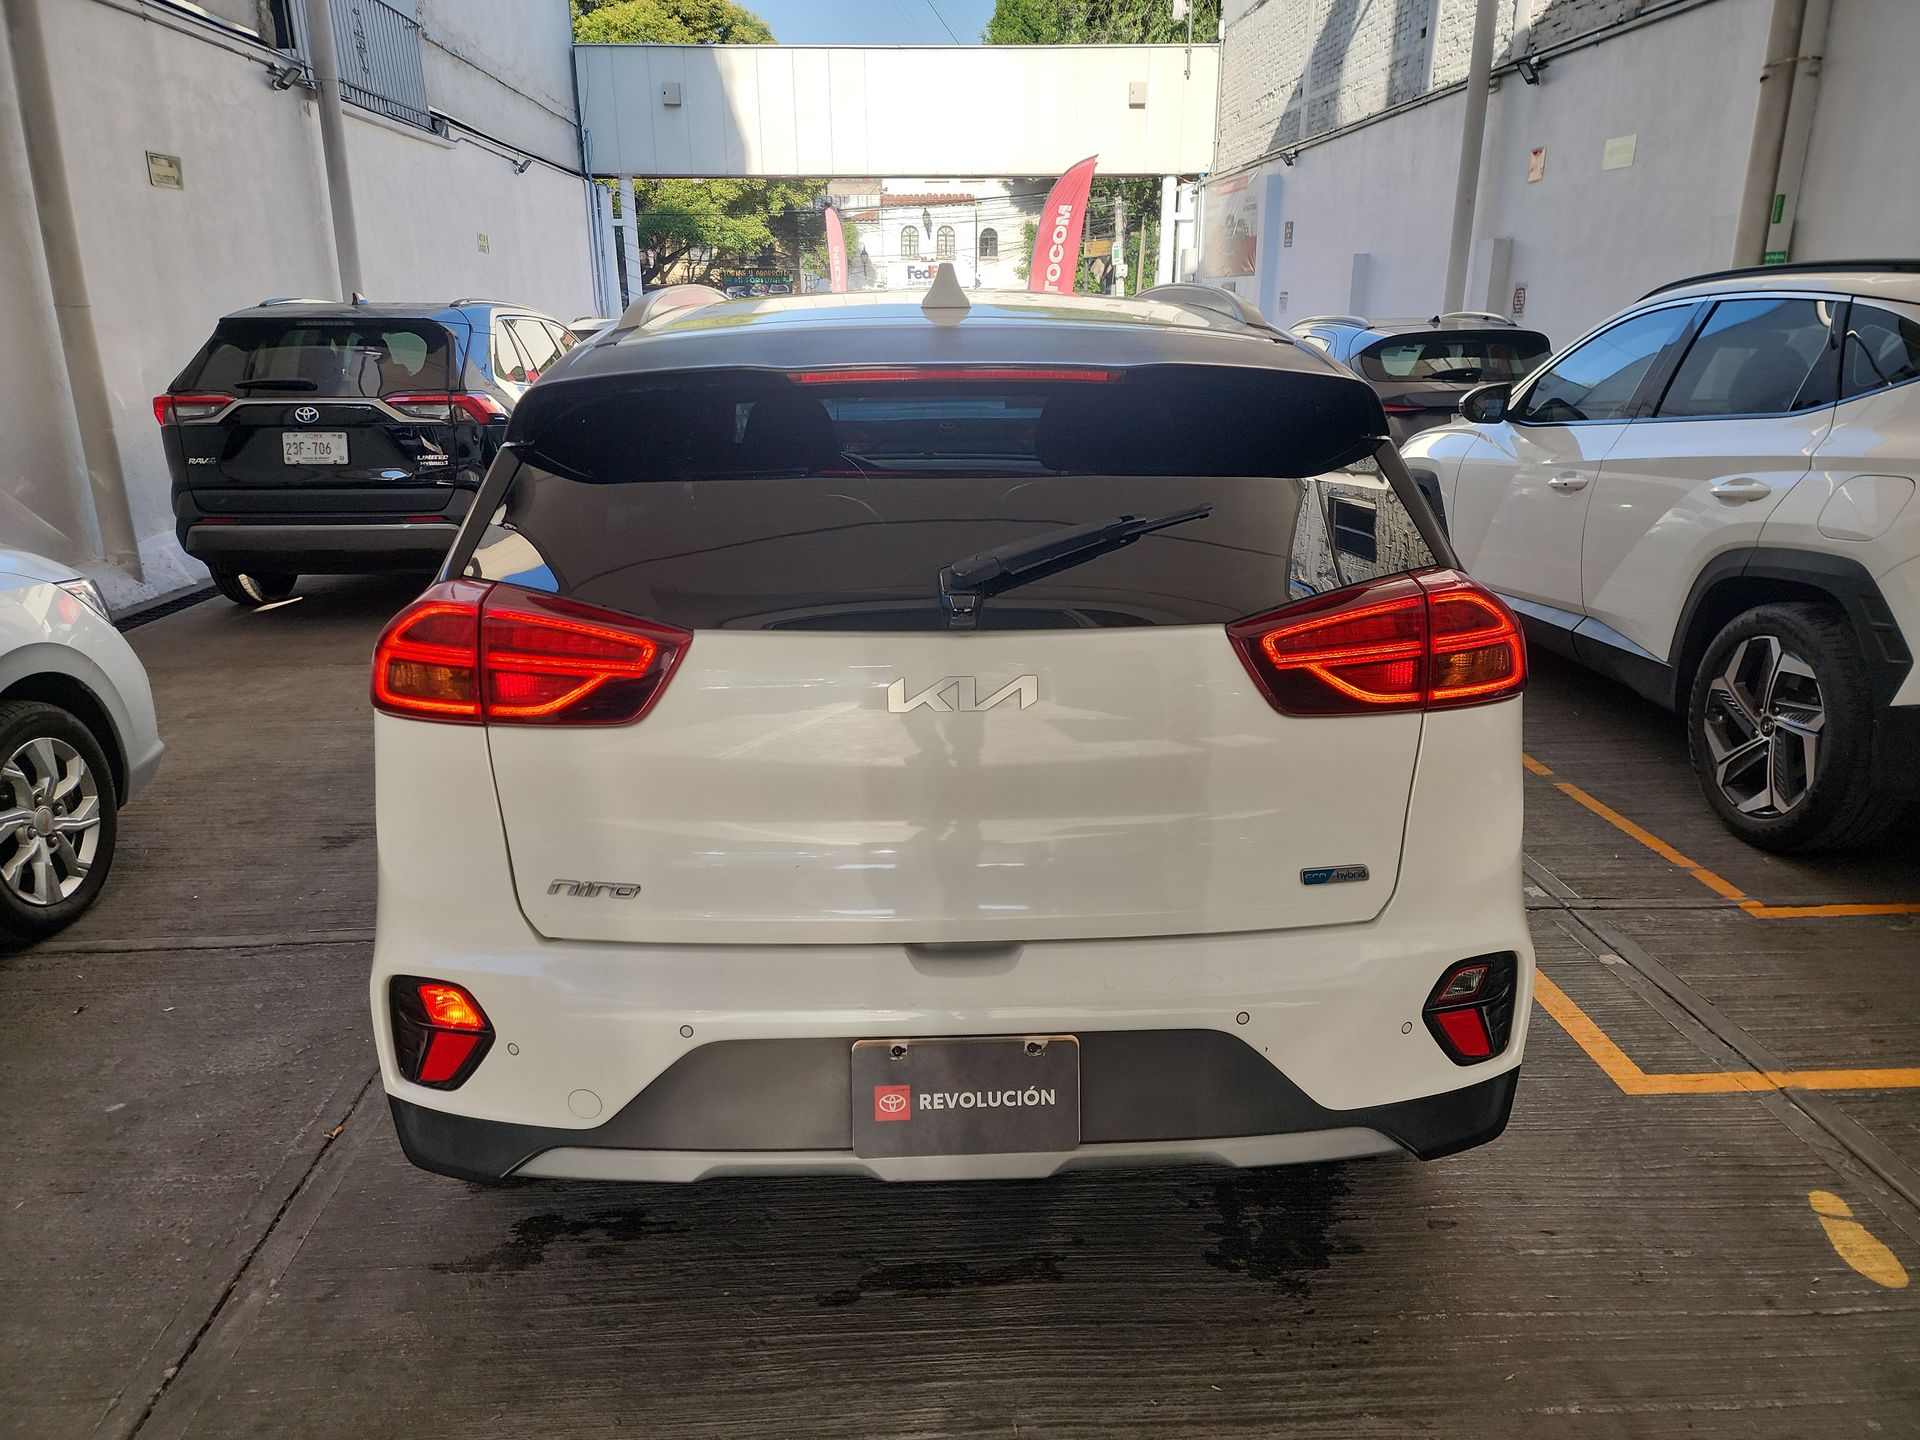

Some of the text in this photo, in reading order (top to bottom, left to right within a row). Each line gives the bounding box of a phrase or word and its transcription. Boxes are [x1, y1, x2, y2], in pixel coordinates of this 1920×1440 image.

[907, 265, 938, 279] FedE
[285, 441, 332, 456] 23F-706
[887, 674, 1039, 713] KIA
[1336, 869, 1366, 880] hybrid
[919, 1085, 1056, 1110] REVOLUCIÓN
